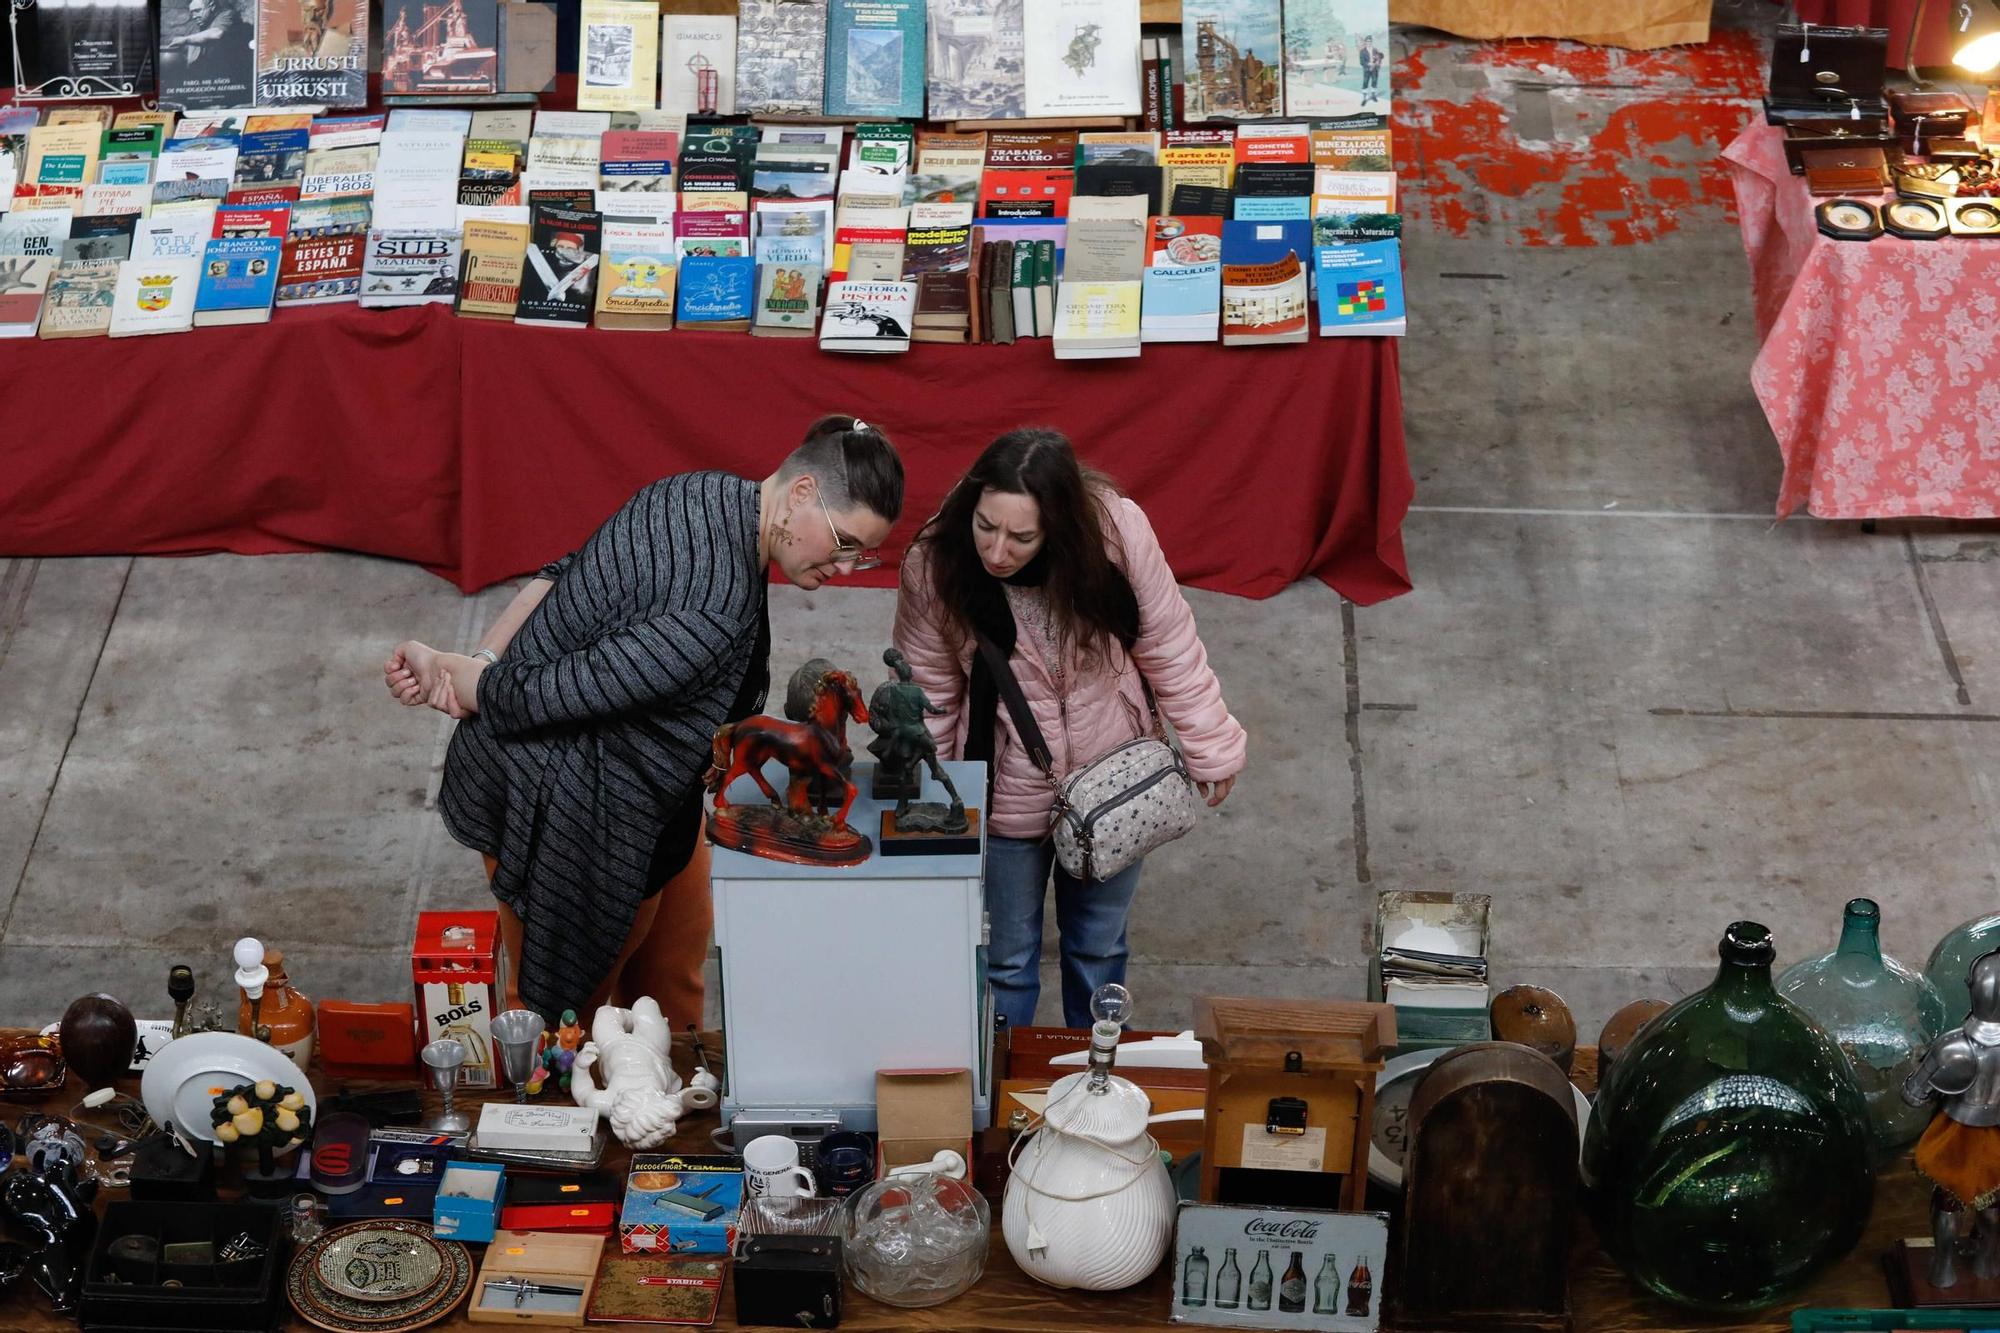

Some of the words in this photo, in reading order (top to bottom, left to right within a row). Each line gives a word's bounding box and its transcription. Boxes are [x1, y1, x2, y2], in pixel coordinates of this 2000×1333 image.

[274, 56, 358, 71] URRUSTI
[263, 82, 347, 98] URRUSTI
[1315, 139, 1386, 149] MINERALOGÍA
[306, 173, 373, 185] LIBERALES
[305, 184, 327, 193] DE
[334, 181, 371, 192] 1808
[907, 229, 968, 238] modelismo
[1361, 227, 1394, 236] Naturaleza
[23, 236, 49, 249] GEN
[152, 236, 170, 246] YO
[908, 236, 964, 245] ferroviario
[153, 246, 162, 256] A
[295, 246, 334, 260] REYES
[338, 244, 354, 256] DE
[376, 240, 449, 255] SUB
[297, 256, 347, 272] ESPAÑA
[1153, 265, 1216, 277] CALCULUS
[841, 293, 906, 301] PISTOLA
[542, 301, 586, 310] VIKINGOS
[605, 297, 670, 308] Enciclopedia
[684, 302, 742, 312] Enciclopedia
[434, 1000, 482, 1027] BOLS
[635, 1163, 682, 1171] RECOGEMIGAS
[666, 1278, 704, 1286] STABILO
